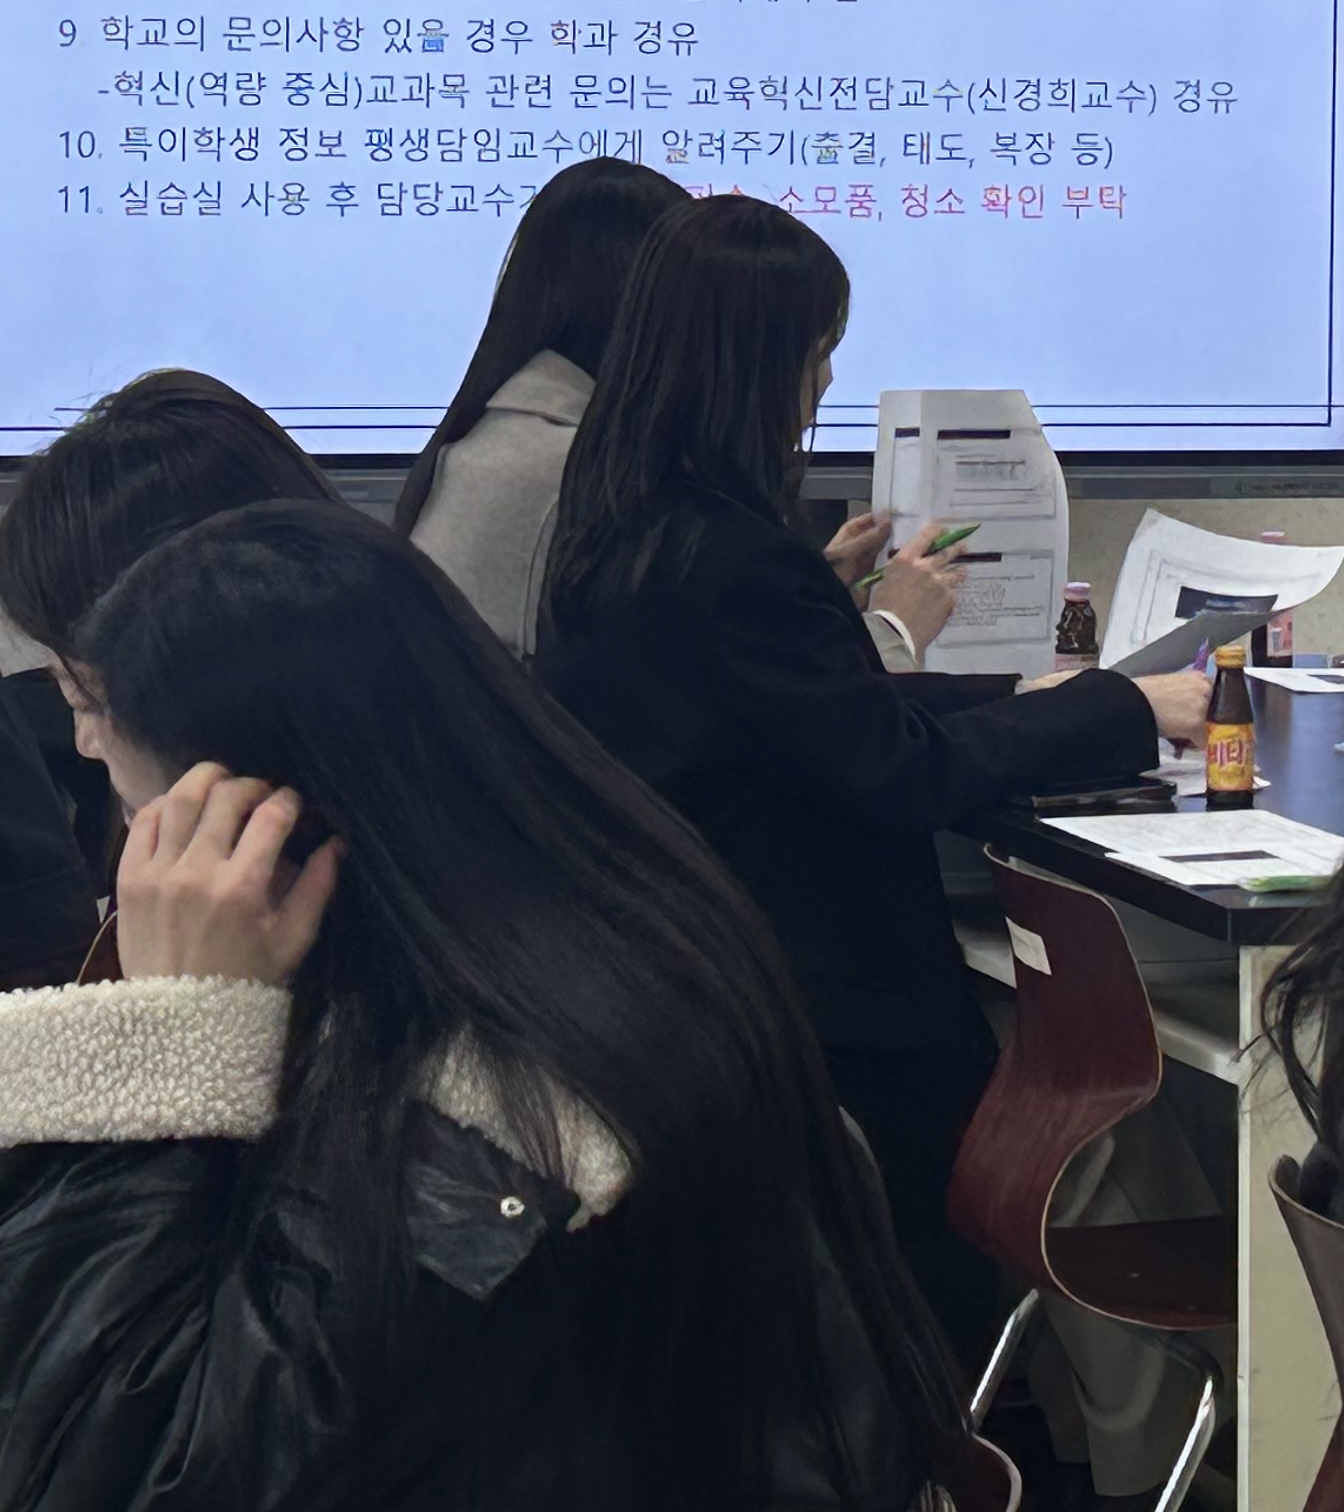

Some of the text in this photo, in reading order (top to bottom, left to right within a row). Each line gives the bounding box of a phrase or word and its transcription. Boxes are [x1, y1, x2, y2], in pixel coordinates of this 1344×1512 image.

[101, 14, 205, 53] 학교의
[222, 15, 365, 53] 문의사항
[382, 17, 450, 54] 있을
[466, 18, 533, 55] 경우
[550, 19, 619, 57] 학과
[633, 20, 699, 57] 경유
[282, 71, 470, 110] 중심)교과목
[485, 73, 552, 109] 관련
[569, 74, 673, 111] 문의는
[1173, 79, 1238, 115] 경유
[118, 126, 259, 163] 특이학생
[278, 126, 347, 162] 정보
[902, 131, 975, 169] 태도,
[990, 131, 1056, 167] 복장
[1070, 132, 1113, 170] 등)
[119, 179, 222, 217] 실습실
[240, 180, 310, 217] 사용
[325, 181, 360, 218] 후
[901, 183, 966, 219] 청소
[981, 184, 1044, 219] 확인
[1064, 184, 1127, 220] 부탁
